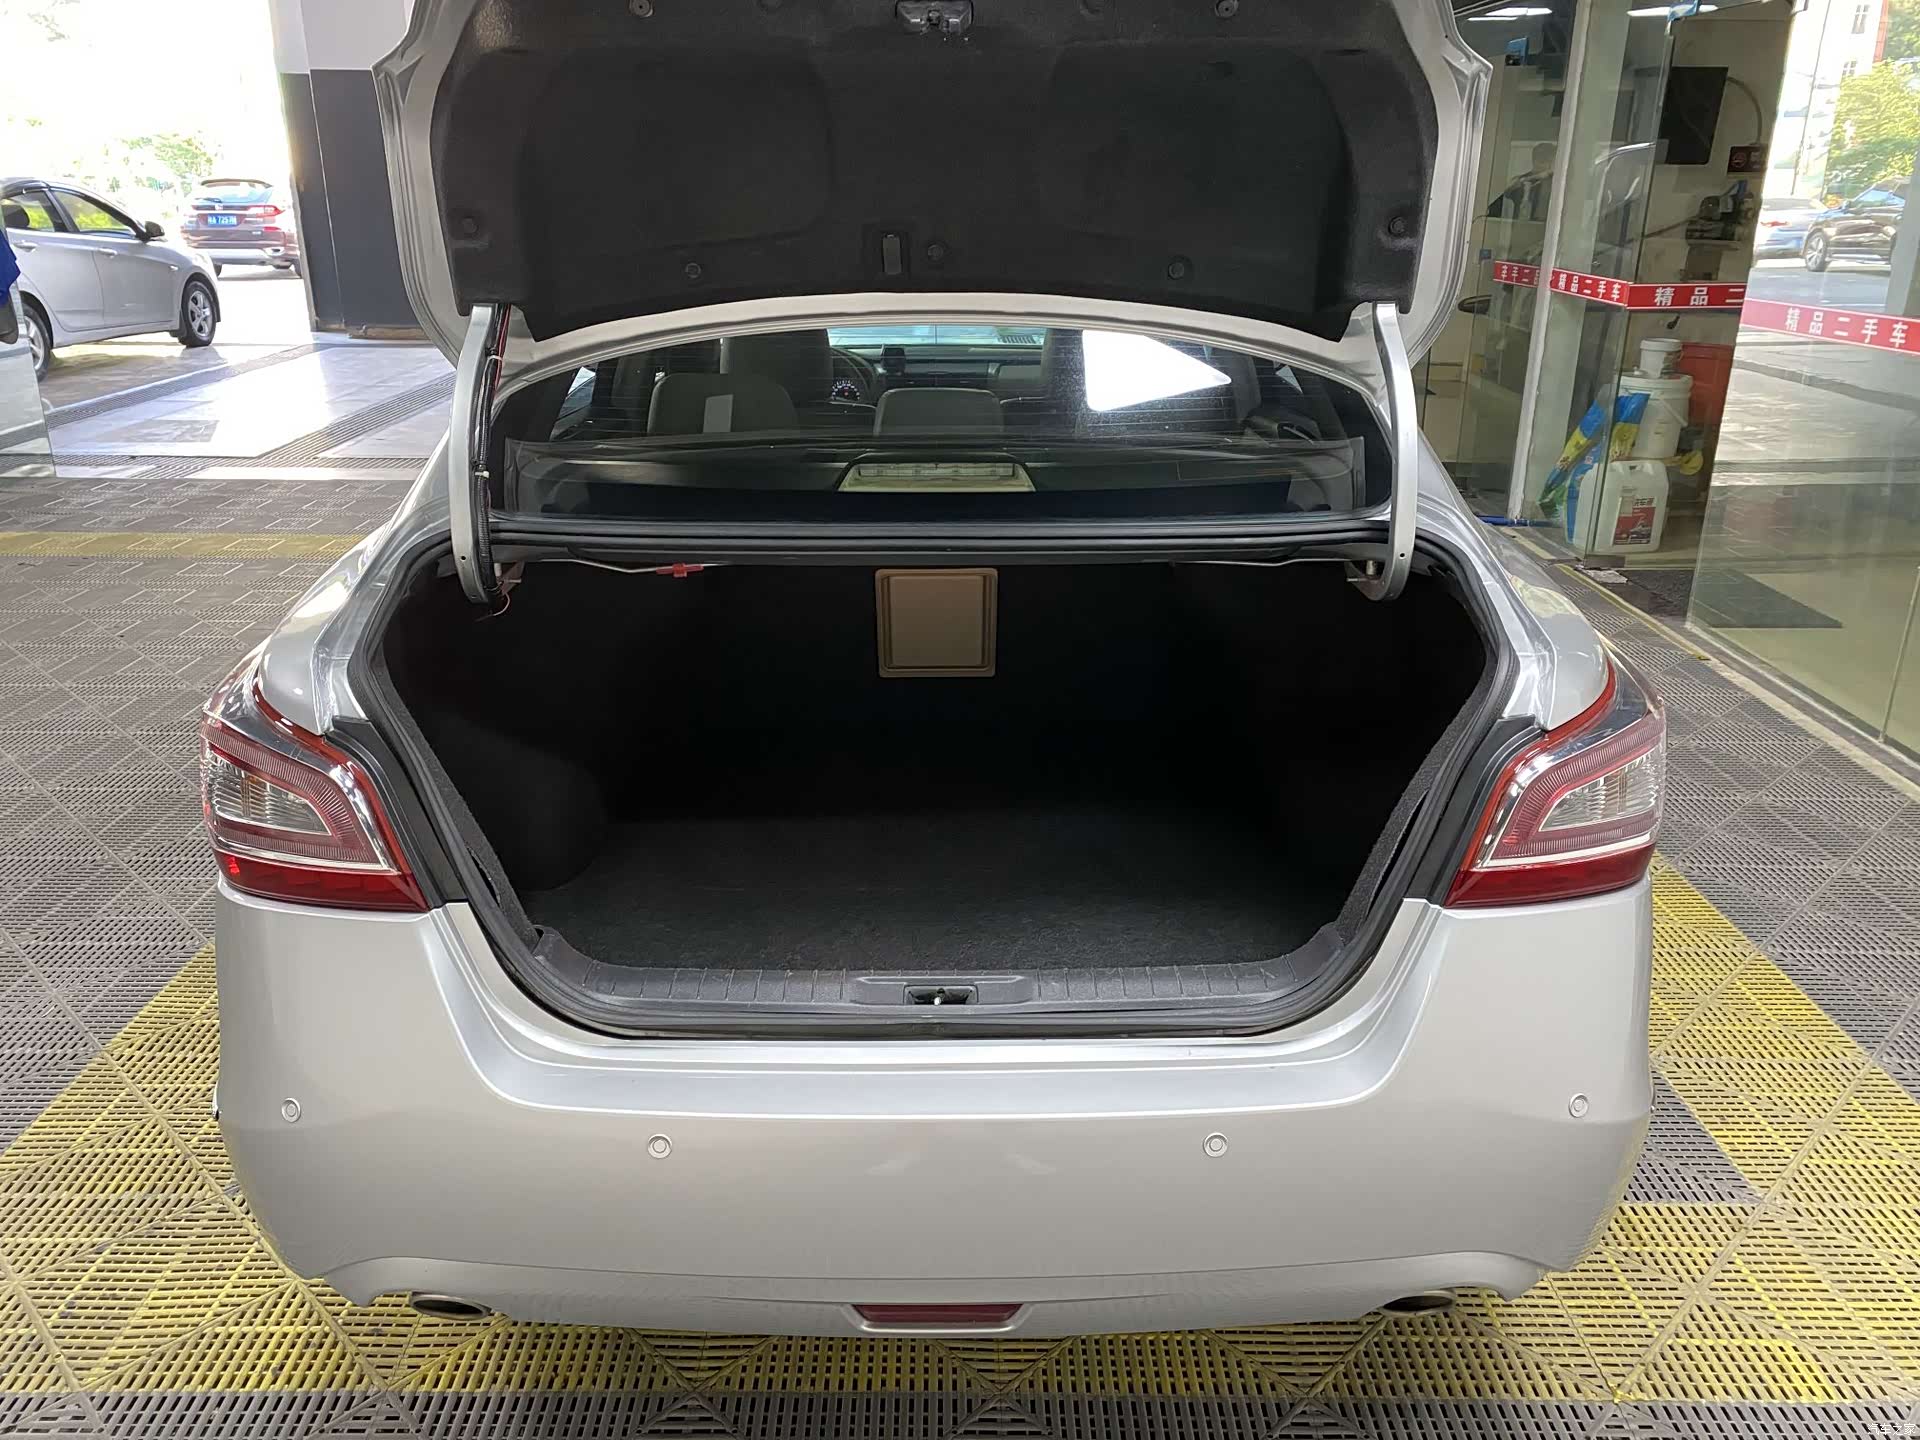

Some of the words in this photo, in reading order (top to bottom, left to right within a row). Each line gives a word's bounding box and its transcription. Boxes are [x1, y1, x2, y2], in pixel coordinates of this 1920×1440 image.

[1558, 273, 1621, 301] 精品二手车
[1654, 286, 1744, 306] 精品二
[1785, 307, 1908, 348] 精品二手车
